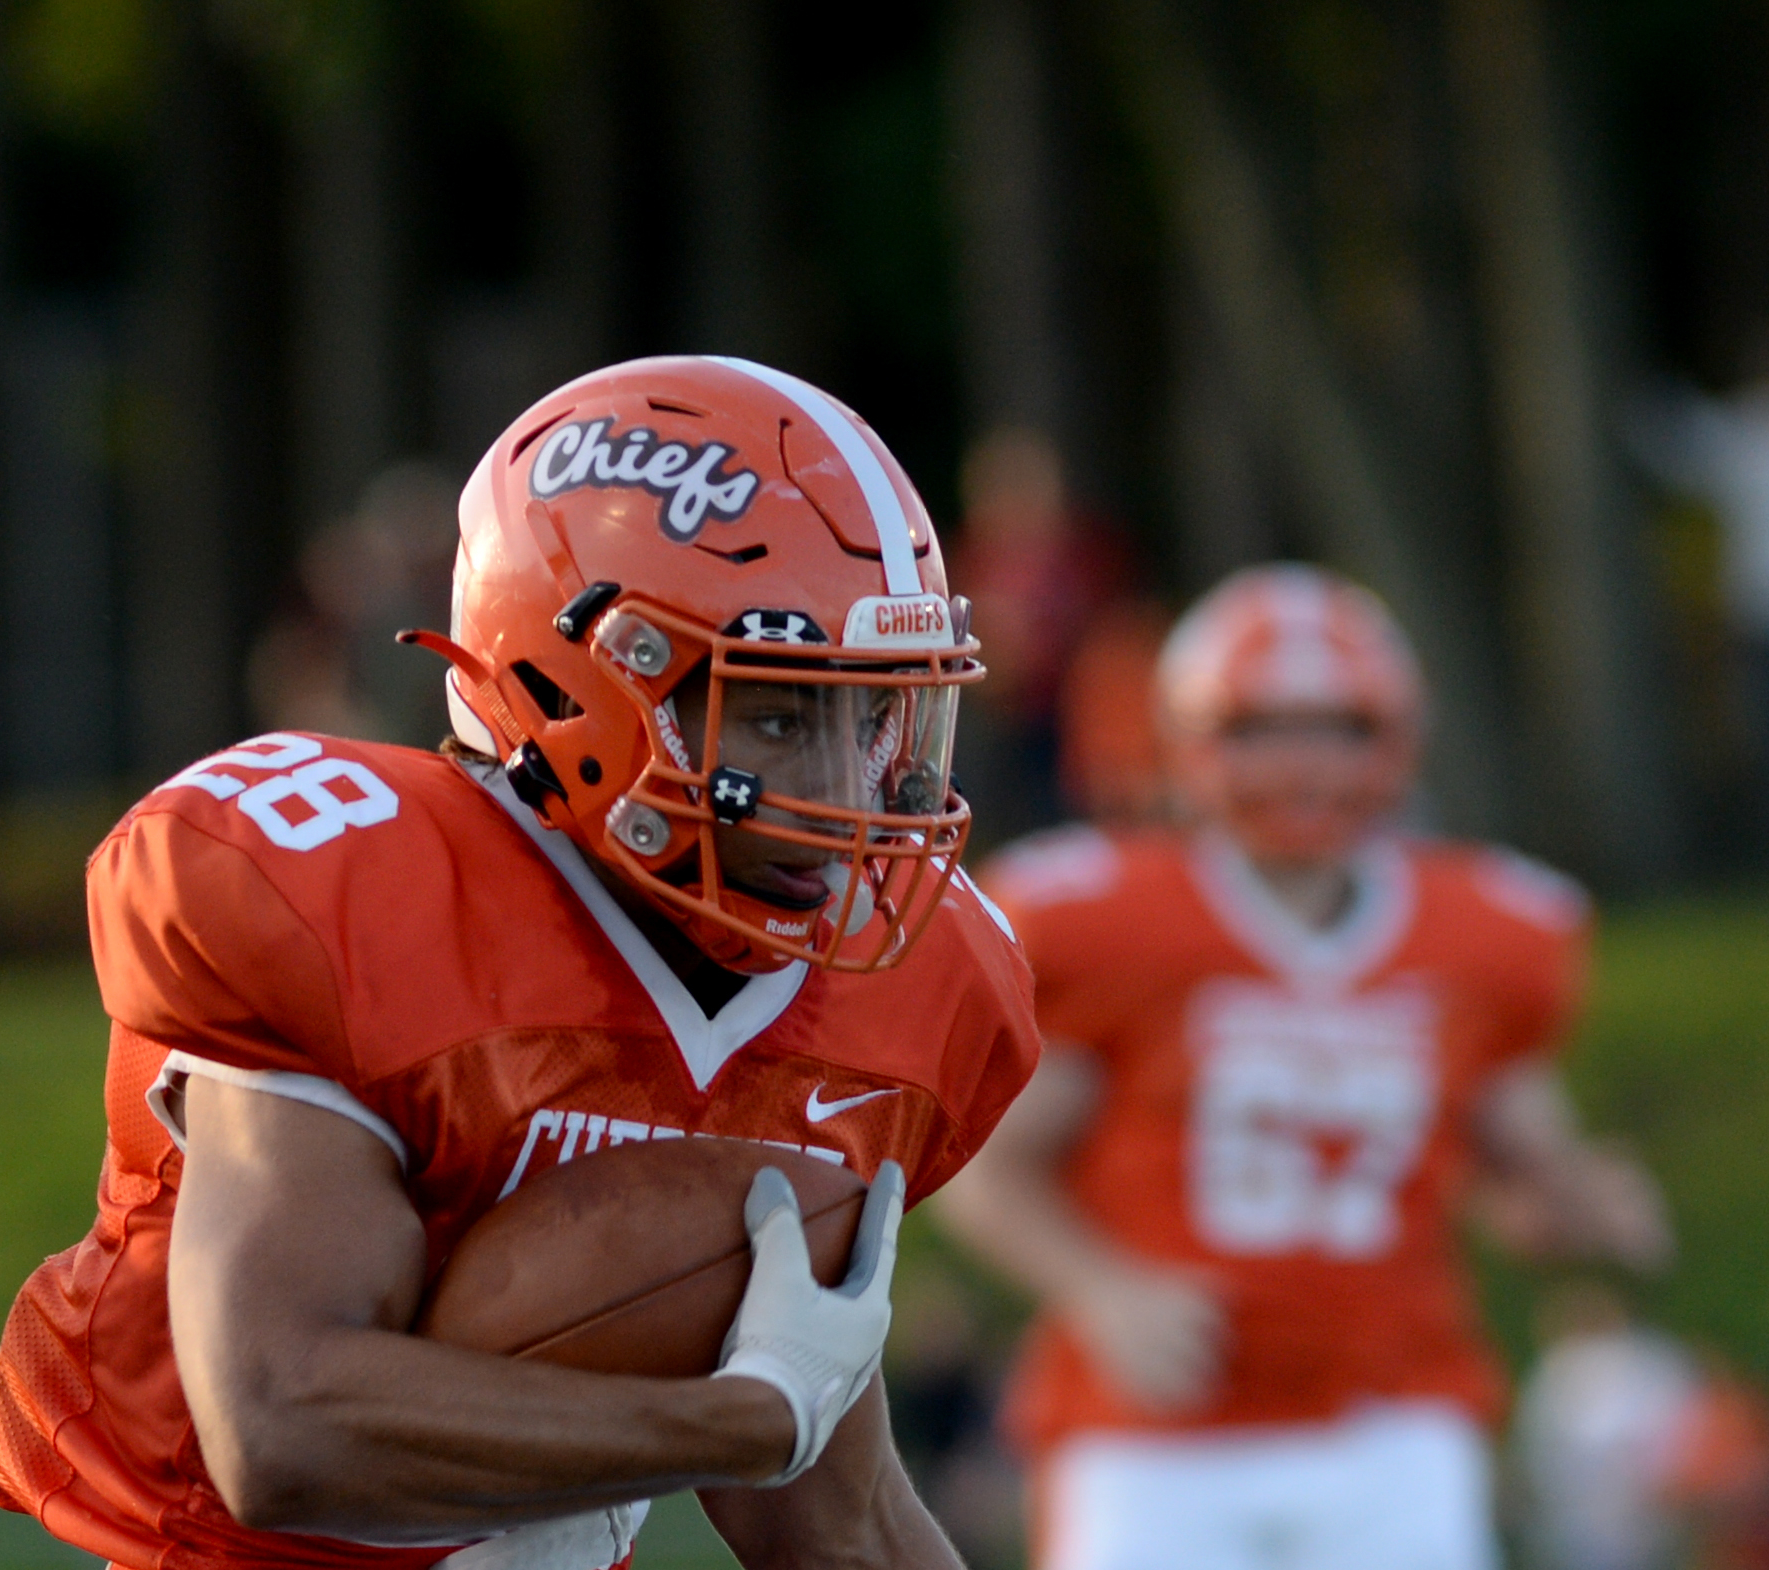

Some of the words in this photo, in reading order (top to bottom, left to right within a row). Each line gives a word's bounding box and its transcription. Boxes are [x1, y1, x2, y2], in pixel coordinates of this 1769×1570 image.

[530, 418, 760, 537] Chiefs
[875, 602, 944, 635] CHIEFS
[151, 732, 399, 852] 28
[1188, 1048, 1432, 1256] 67
